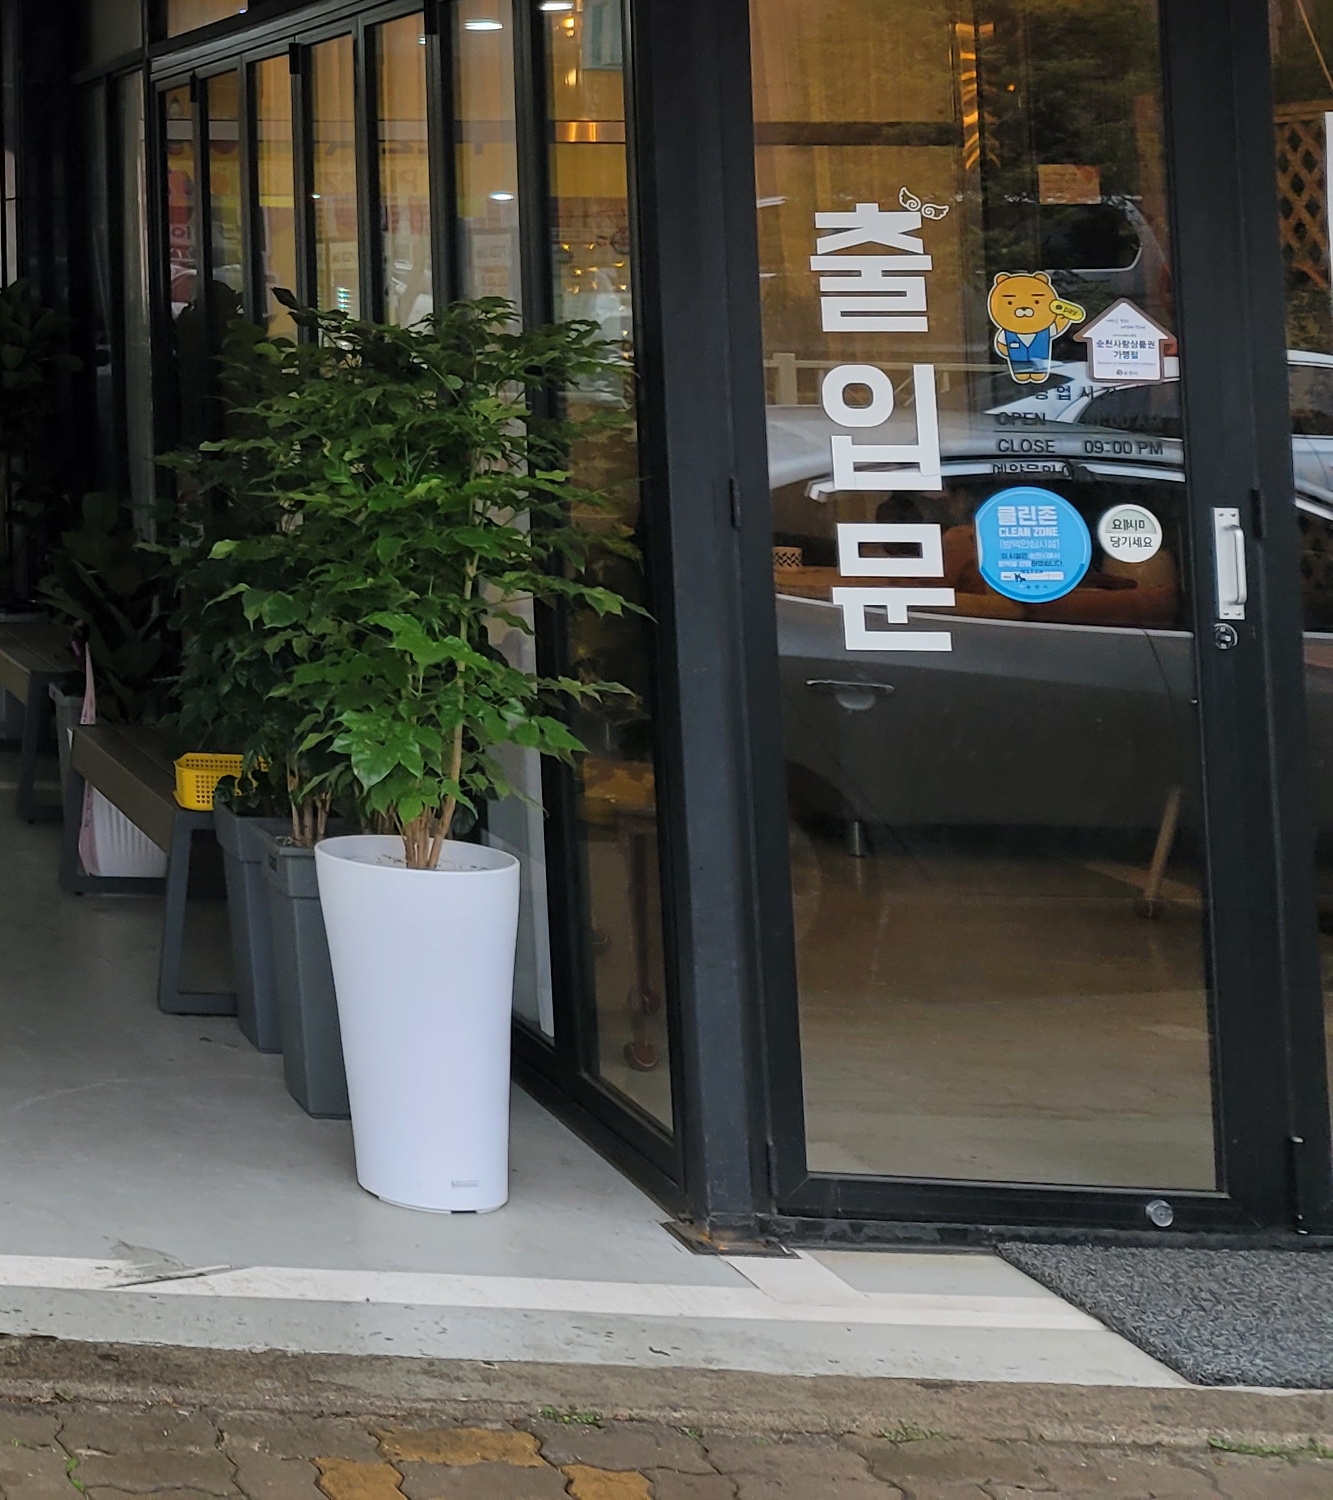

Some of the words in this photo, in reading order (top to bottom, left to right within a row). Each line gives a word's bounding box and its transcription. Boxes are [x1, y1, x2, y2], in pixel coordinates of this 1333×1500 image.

[1063, 306, 1078, 316] pay
[994, 411, 1046, 426] OPEN
[809, 202, 956, 651] 출입문
[998, 438, 1056, 453] CLOSE
[1084, 440, 1133, 454] 09:00
[1137, 441, 1164, 456] PM
[997, 505, 1058, 526] 클린존
[998, 527, 1031, 537] CLEAN
[1032, 527, 1059, 537] ZONE
[1110, 535, 1153, 549] 당기세요
